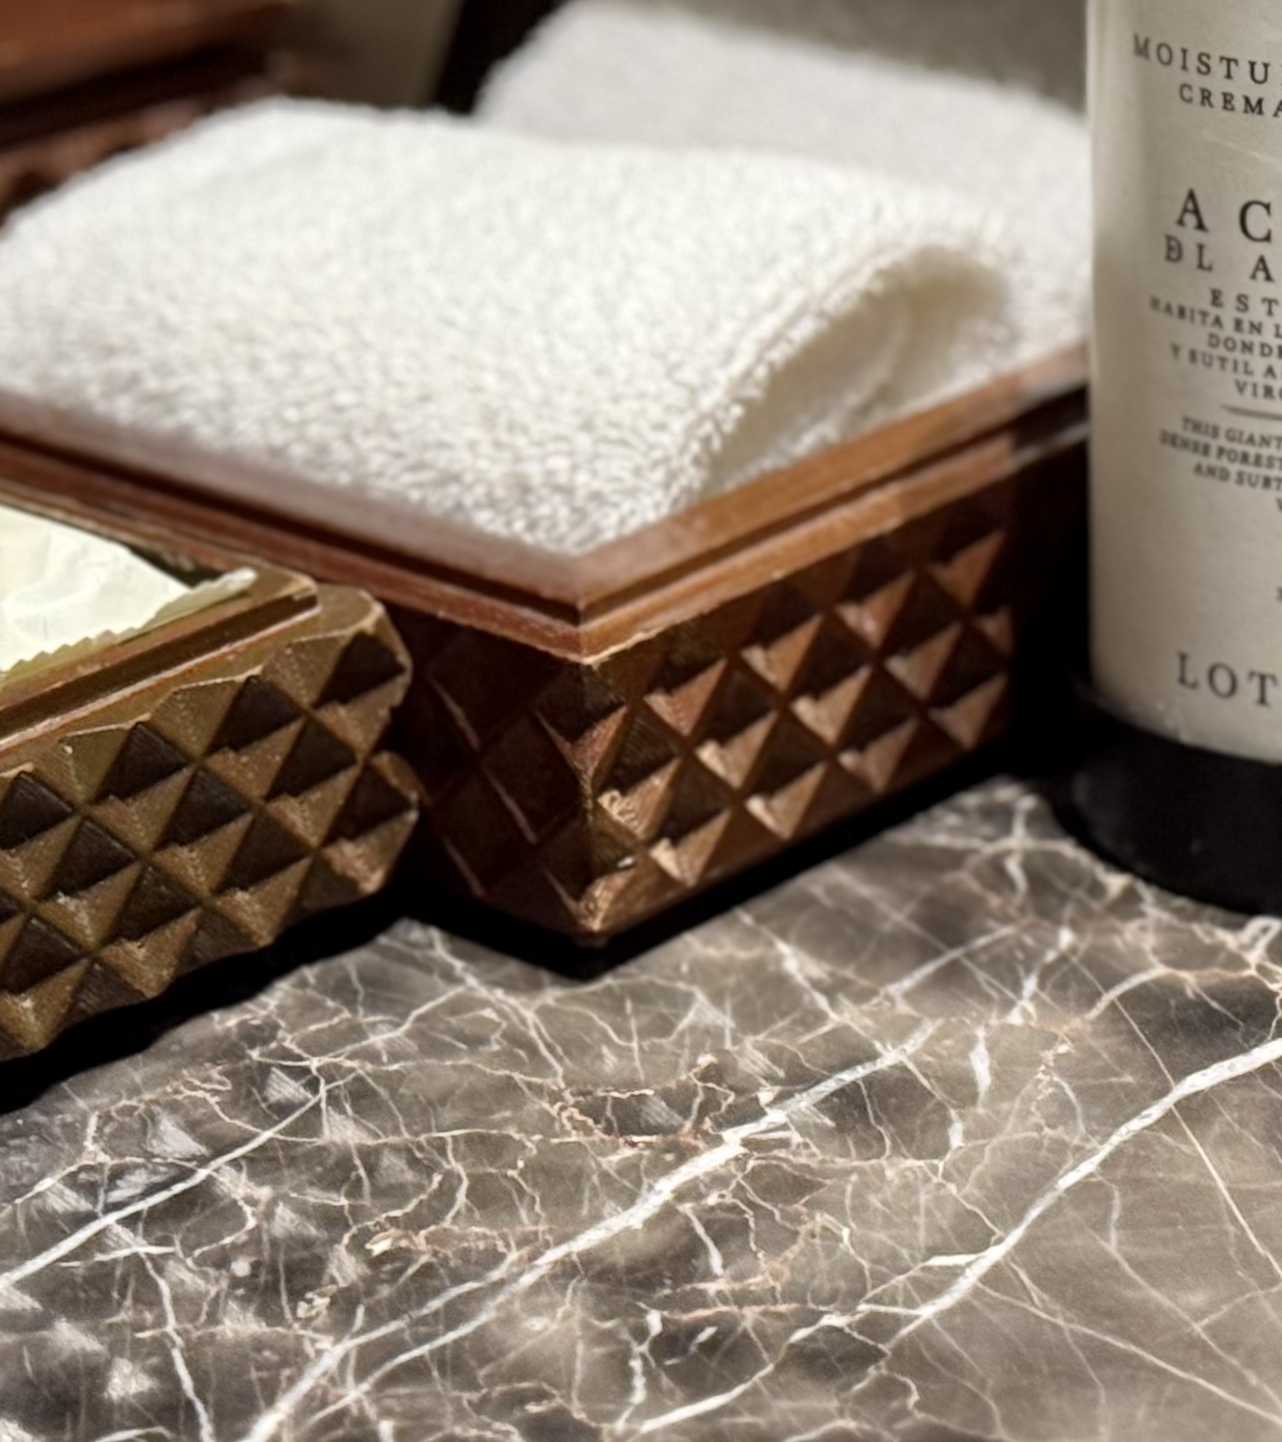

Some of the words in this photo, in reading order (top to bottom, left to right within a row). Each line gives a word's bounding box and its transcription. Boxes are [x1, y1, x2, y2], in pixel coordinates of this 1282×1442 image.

[1149, 295, 1224, 330] HABITA
[1233, 318, 1262, 335] EN
[1170, 342, 1182, 359] Y
[1188, 349, 1254, 376] SUTIL
[1182, 416, 1220, 439] THIS
[1160, 429, 1211, 457] DENSE
[1193, 462, 1231, 482] AND
